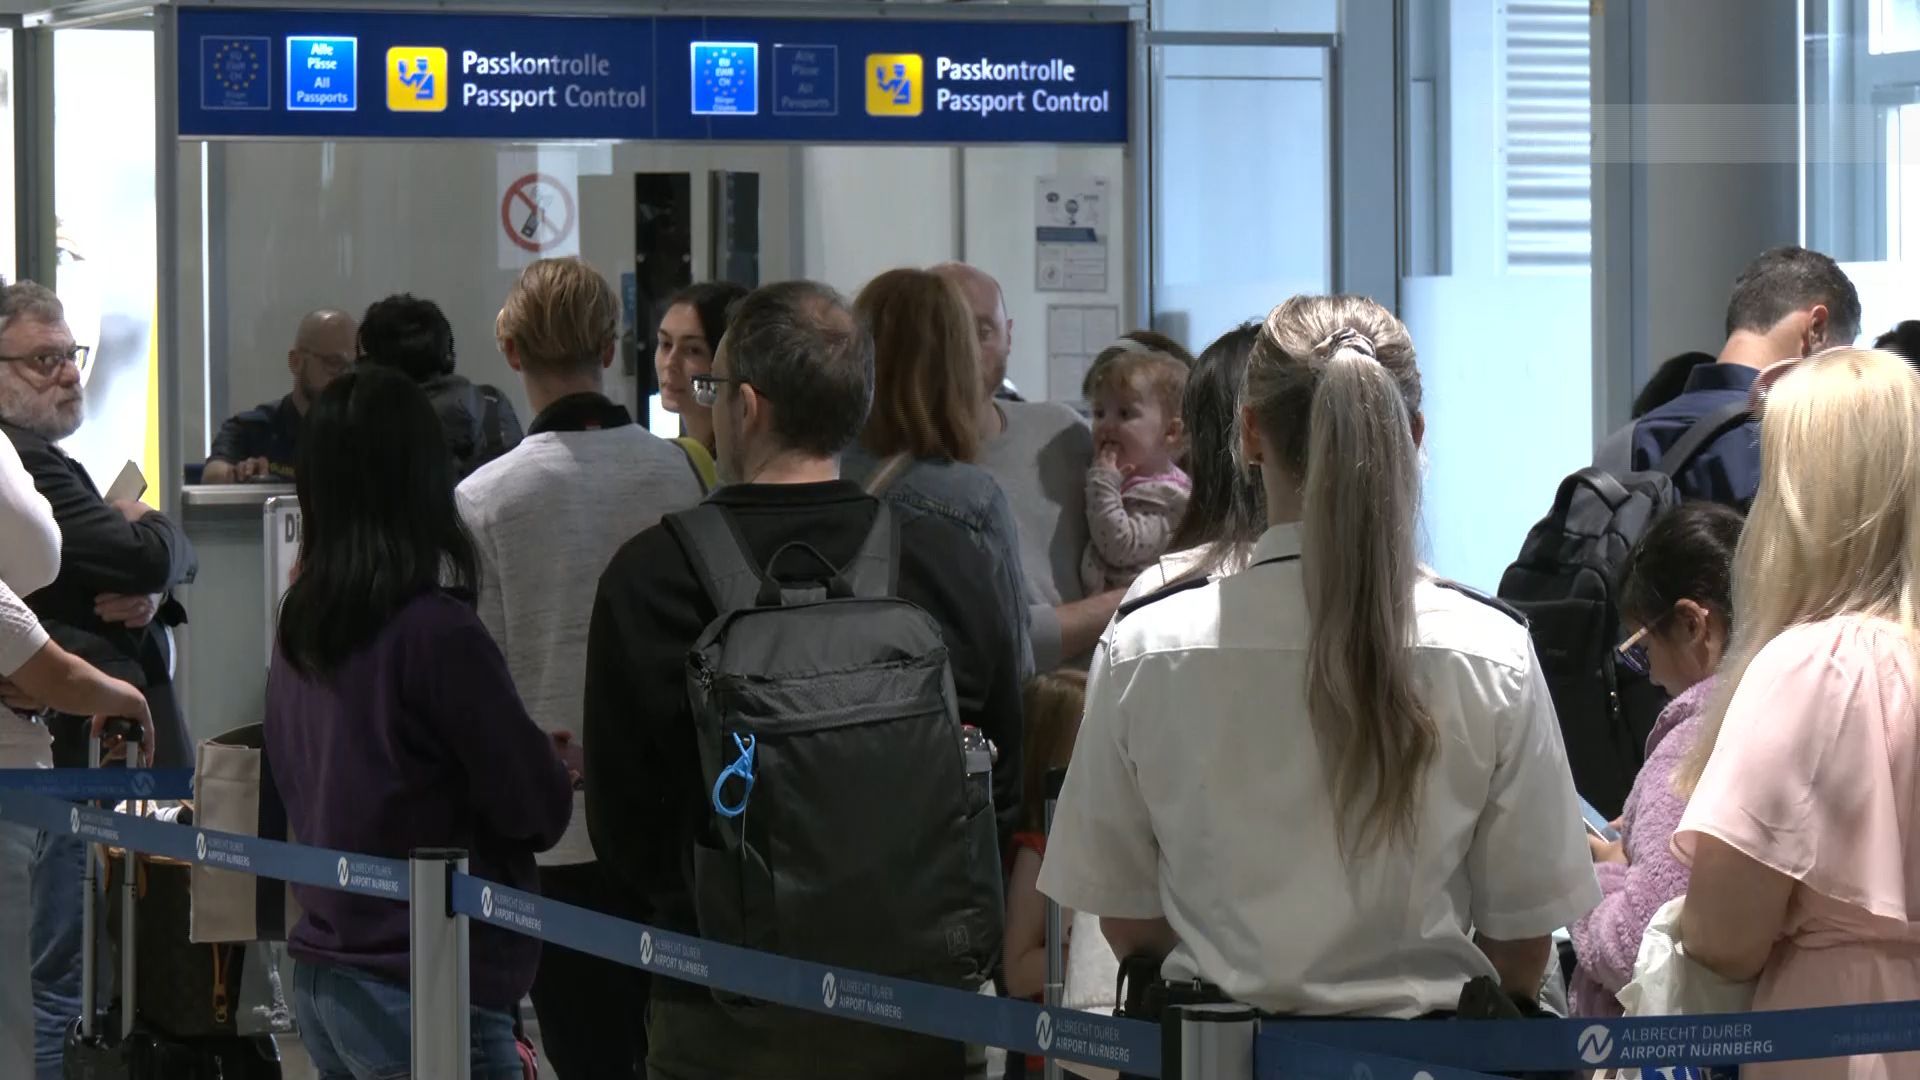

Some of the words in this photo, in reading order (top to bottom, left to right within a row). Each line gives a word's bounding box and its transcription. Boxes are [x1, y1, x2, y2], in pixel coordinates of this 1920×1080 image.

[311, 42, 334, 56] Alle
[307, 57, 338, 70] Pässe
[462, 50, 610, 76] Passkontrolle
[936, 56, 1076, 82] Passkontrolle
[314, 77, 331, 89] All
[296, 90, 349, 105] Passports
[462, 83, 557, 113] Passport
[564, 84, 646, 108] Control
[936, 88, 1025, 117] Passport
[1032, 89, 1109, 113] Control
[654, 953, 677, 969] AIRPORT
[839, 995, 868, 1012] AIRPORT
[1622, 1026, 1697, 1042] ALBRECHT
[1055, 1036, 1088, 1054] AIRPORT
[1620, 1043, 1686, 1060] AIRPORT
